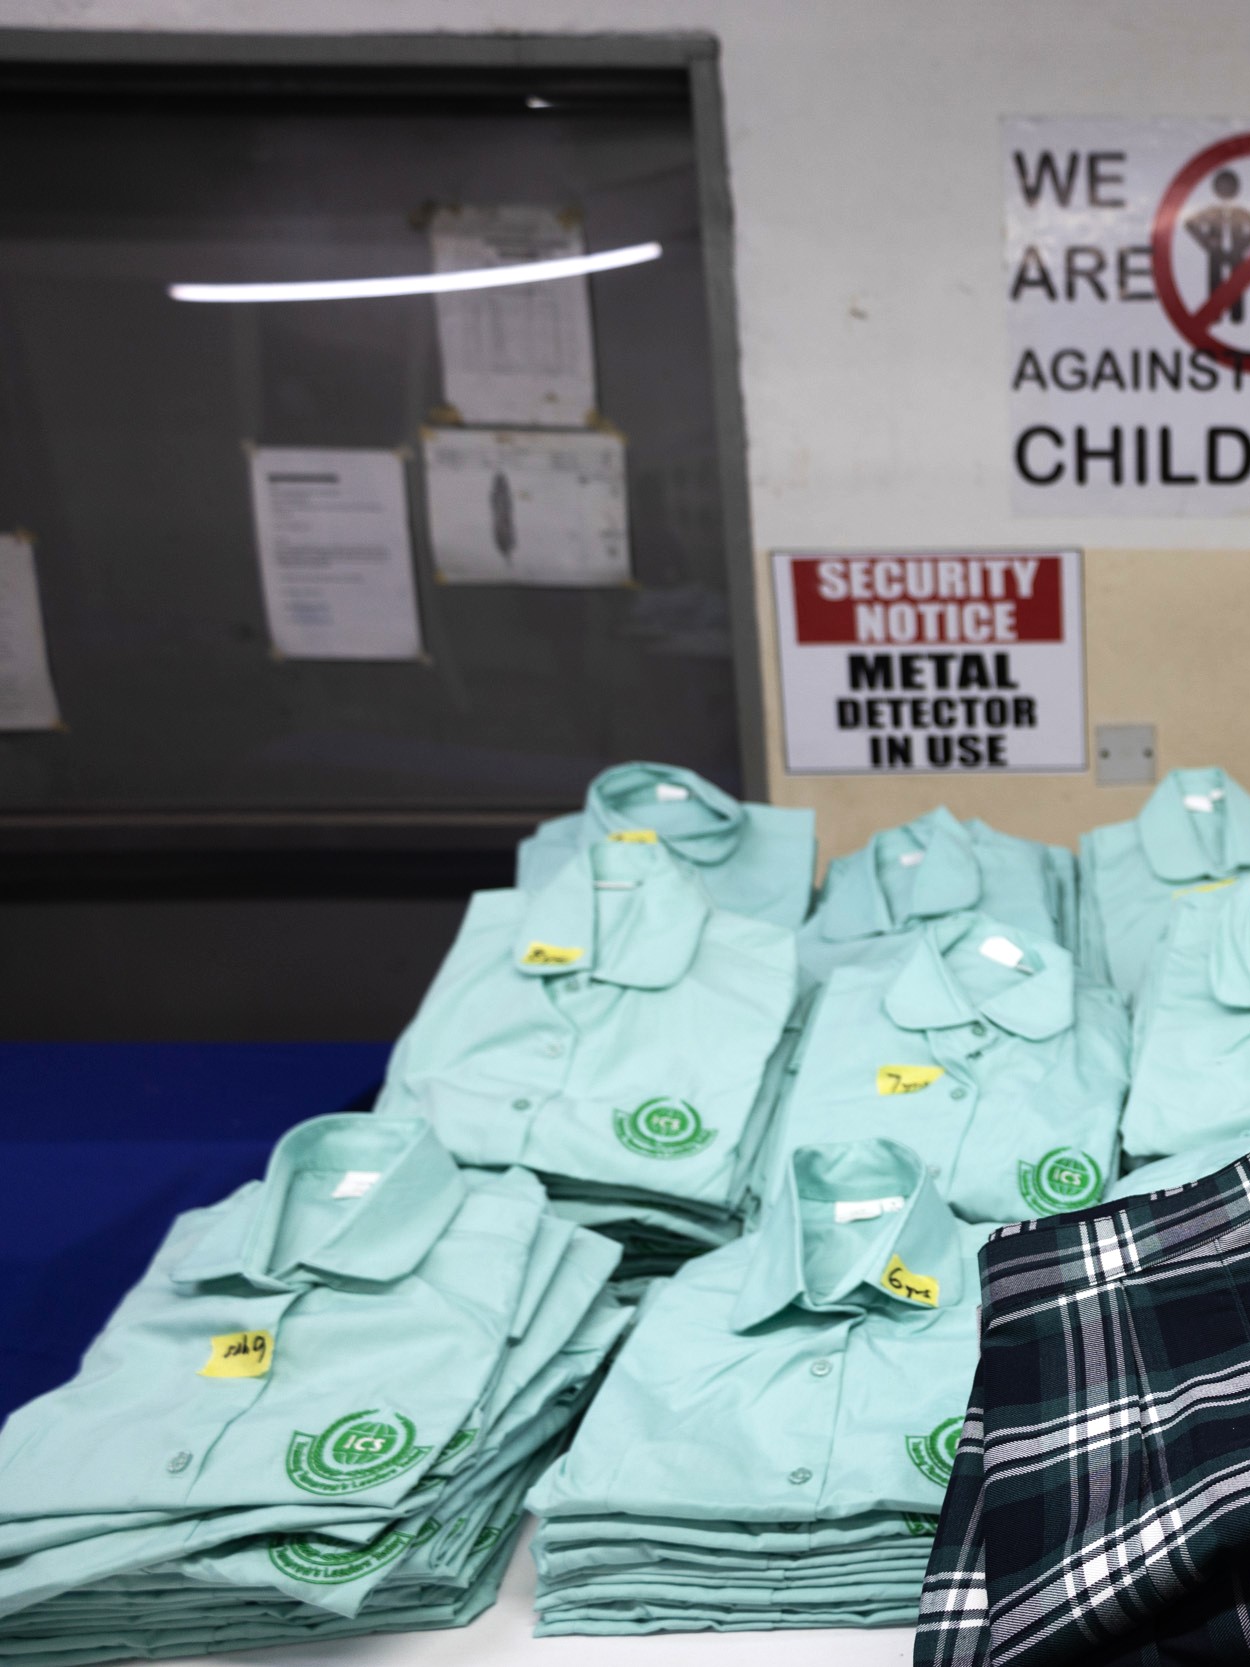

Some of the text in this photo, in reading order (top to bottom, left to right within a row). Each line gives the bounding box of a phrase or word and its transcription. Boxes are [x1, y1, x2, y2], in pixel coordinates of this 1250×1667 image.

[1014, 151, 1127, 208] WE
[1011, 246, 1158, 302] ARE
[817, 559, 1039, 601] SECURITY
[855, 601, 1018, 643] NOTICE
[848, 652, 1019, 690] METAL
[838, 697, 1037, 729] DETECTOR
[870, 734, 1008, 769] IN USE
[343, 1434, 387, 1452] ICS
